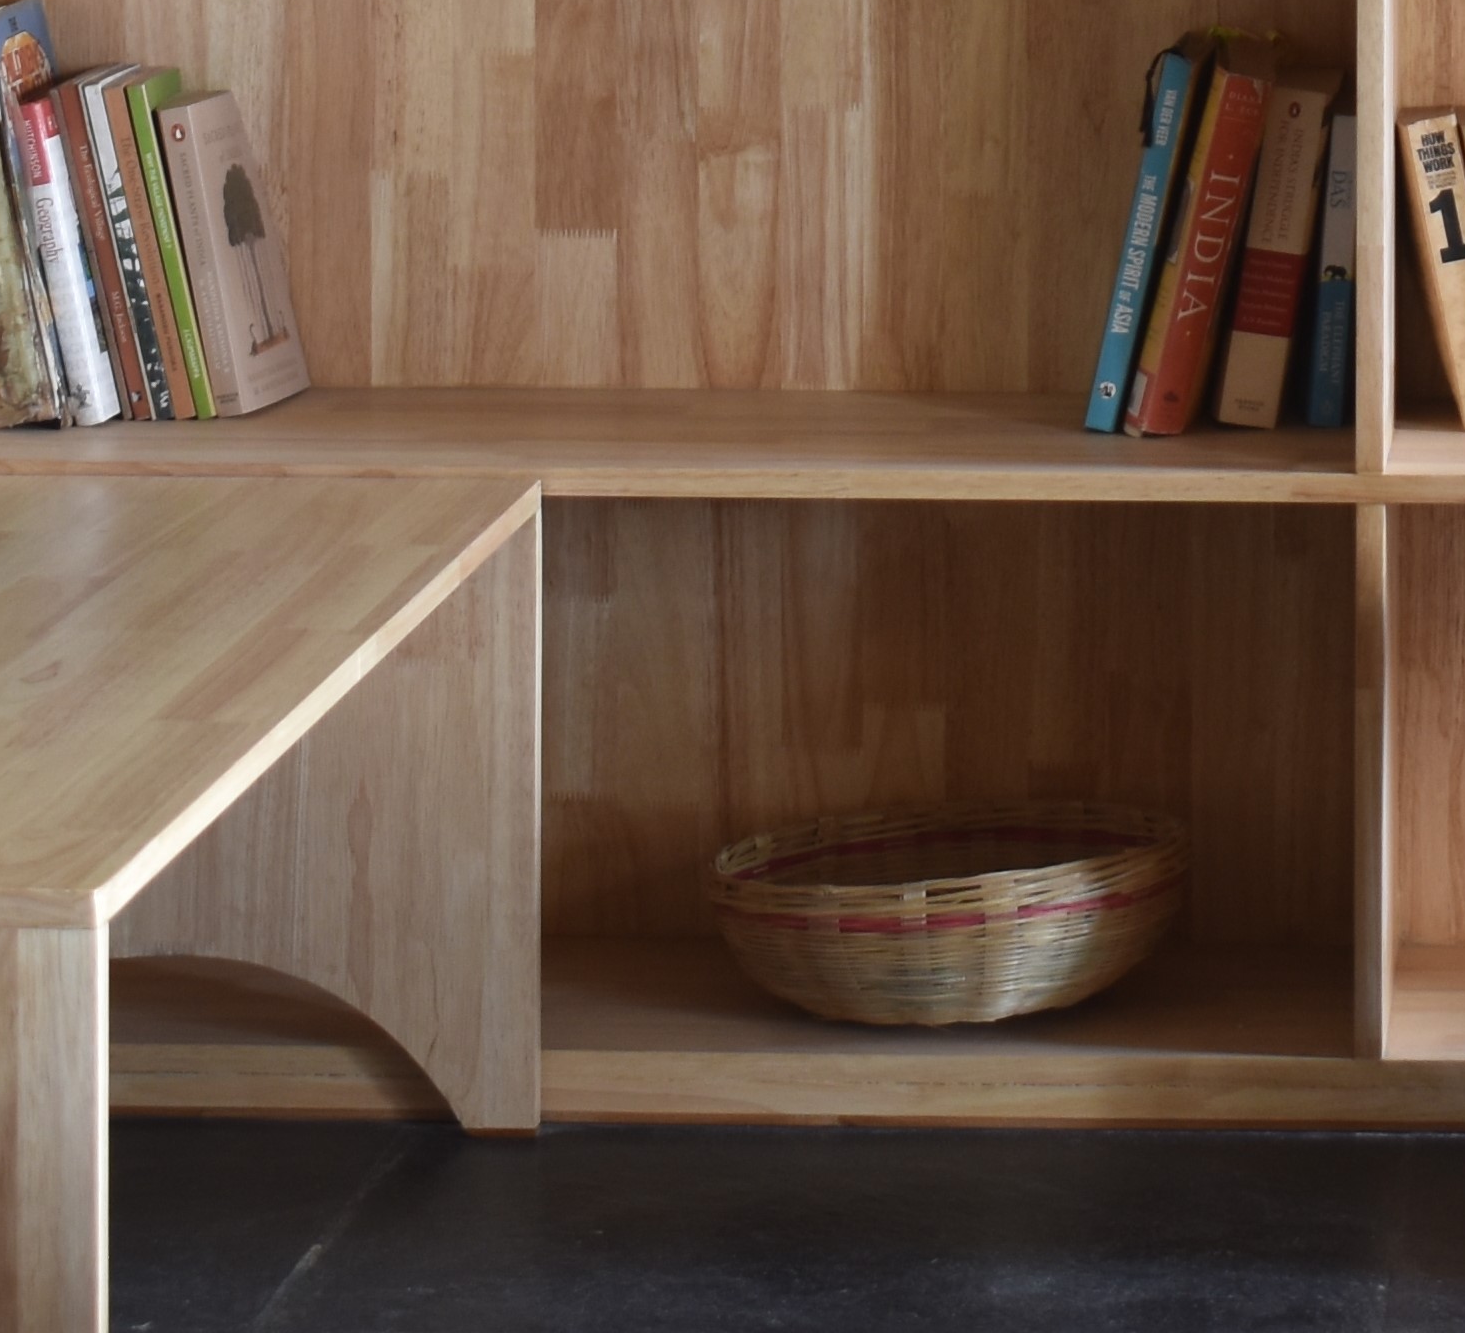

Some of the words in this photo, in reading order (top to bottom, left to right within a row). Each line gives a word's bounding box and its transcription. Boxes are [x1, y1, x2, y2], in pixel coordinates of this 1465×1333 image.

[23, 119, 42, 178] HUTCHINSON
[79, 144, 89, 161] The
[1417, 143, 1455, 161] THINGS
[1421, 131, 1445, 146] HOW
[1423, 156, 1454, 173] WORK
[81, 163, 100, 209] Ecological
[1141, 174, 1156, 191] THE
[34, 196, 62, 264] Geography
[91, 210, 107, 241] Village
[1130, 192, 1157, 246] MODERN
[1176, 168, 1241, 327] INDIA
[1121, 247, 1146, 290] SPIRIT
[1118, 290, 1131, 301] OF
[1111, 303, 1133, 334] ASIA
